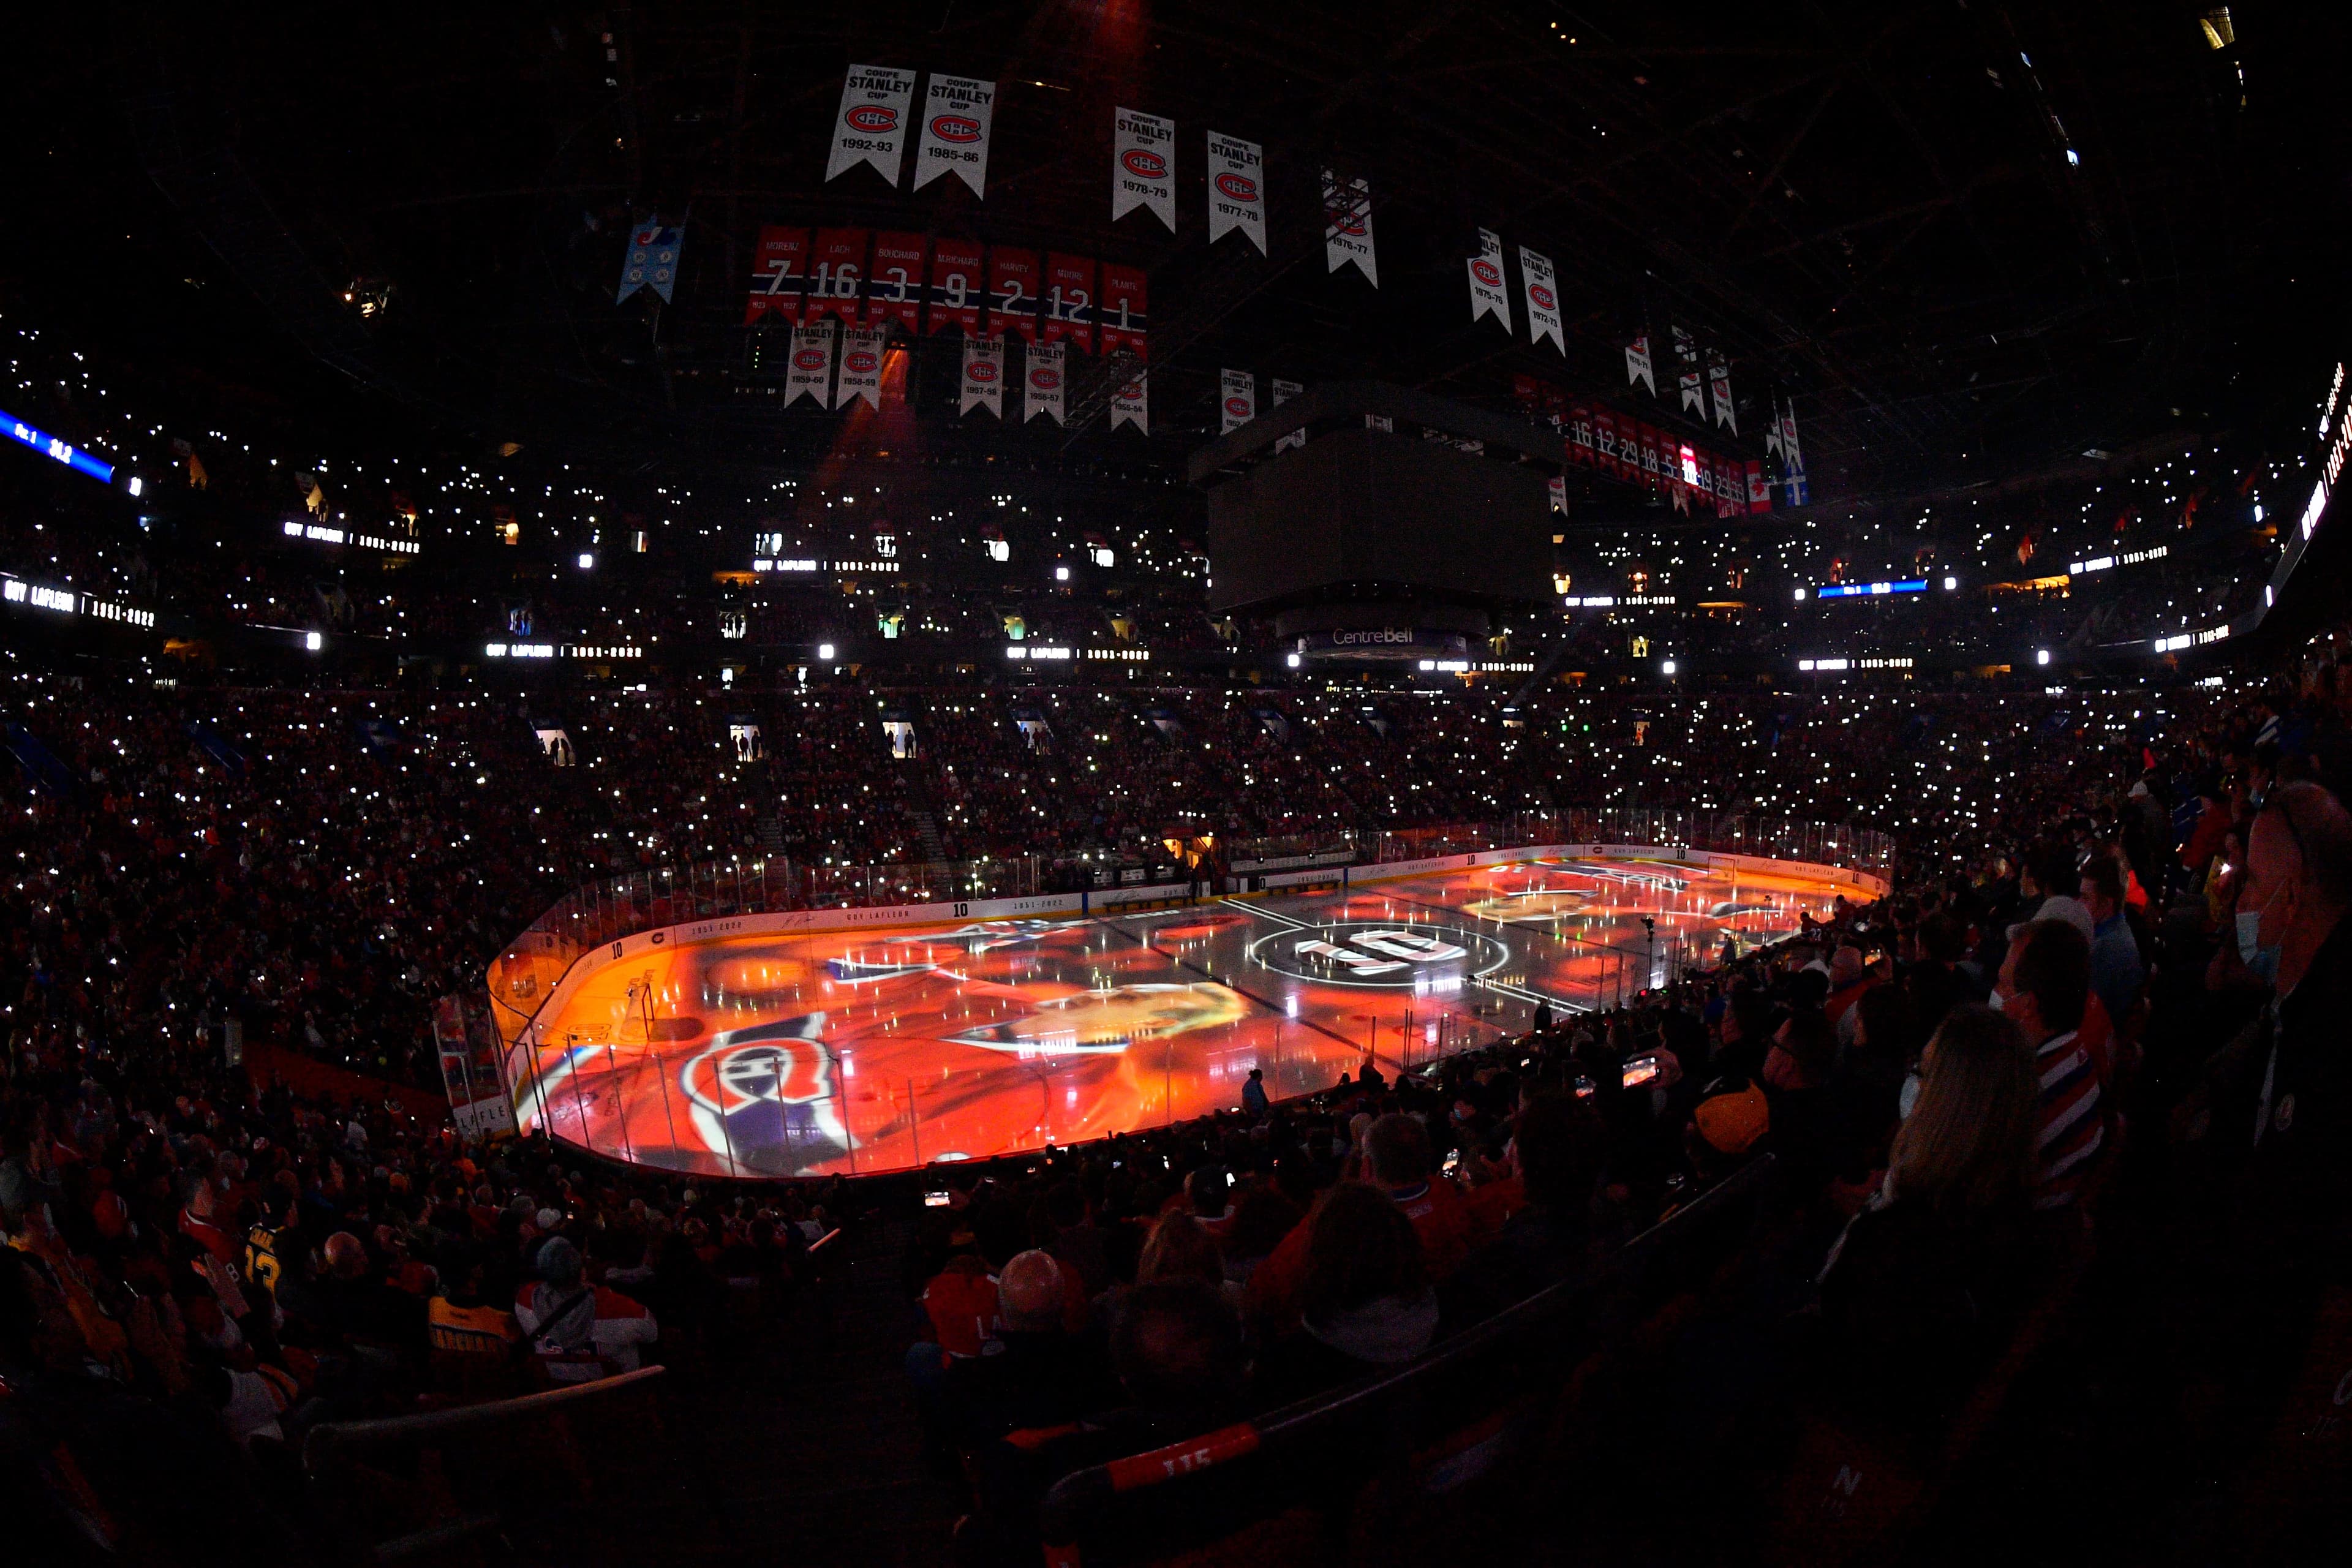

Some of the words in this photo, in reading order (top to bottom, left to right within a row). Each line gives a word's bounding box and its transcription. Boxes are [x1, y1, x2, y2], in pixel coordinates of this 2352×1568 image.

[865, 69, 899, 78] COUPE
[848, 77, 911, 92] STANLEY
[946, 78, 979, 89] COUPE
[930, 85, 991, 104] STANLEY
[950, 101, 970, 110] CUP
[1131, 115, 1161, 126] COUPE
[1118, 119, 1172, 141] STANLEY
[841, 138, 892, 152] 1992-93
[1137, 136, 1155, 145] CUP
[1222, 138, 1249, 151] COUPE
[927, 146, 979, 162] 1985-86
[1211, 143, 1260, 166] STANLEY
[1228, 160, 1244, 170] CUP
[1122, 180, 1167, 198] 1978-79
[1217, 203, 1257, 222] 1977-78
[1332, 236, 1368, 254] 1976-77
[878, 248, 919, 260] BOUCHARD
[1000, 262, 1029, 273] HARVEY
[1057, 269, 1084, 281] MOORE
[1523, 257, 1553, 279] STANLEY
[767, 260, 791, 295] 7
[812, 262, 858, 299] 16
[884, 268, 907, 302] 3
[1112, 279, 1137, 291] PLANTE
[944, 273, 967, 309] 9
[1002, 280, 1023, 315] 2
[1475, 287, 1503, 304] 1975-76
[1048, 285, 1088, 324] 12
[1117, 298, 1131, 330] 1
[1533, 311, 1558, 328] 1972-73
[794, 328, 832, 338] STANLEY
[846, 330, 883, 341] STANLEY
[965, 341, 1003, 352] STANLEY
[1028, 348, 1064, 359] STANLEY
[1223, 377, 1253, 391] STANLEY
[1571, 421, 1593, 448] 16
[1597, 428, 1618, 457] 12
[1619, 438, 1640, 466] 29
[1642, 446, 1659, 473] 18
[1665, 454, 1674, 478] 5
[1699, 467, 1713, 492] 19
[1467, 854, 1475, 865] 10
[1676, 850, 1686, 859] 10
[870, 910, 909, 919] LAFLEUR
[954, 903, 968, 918] 10
[612, 941, 623, 960] 10
